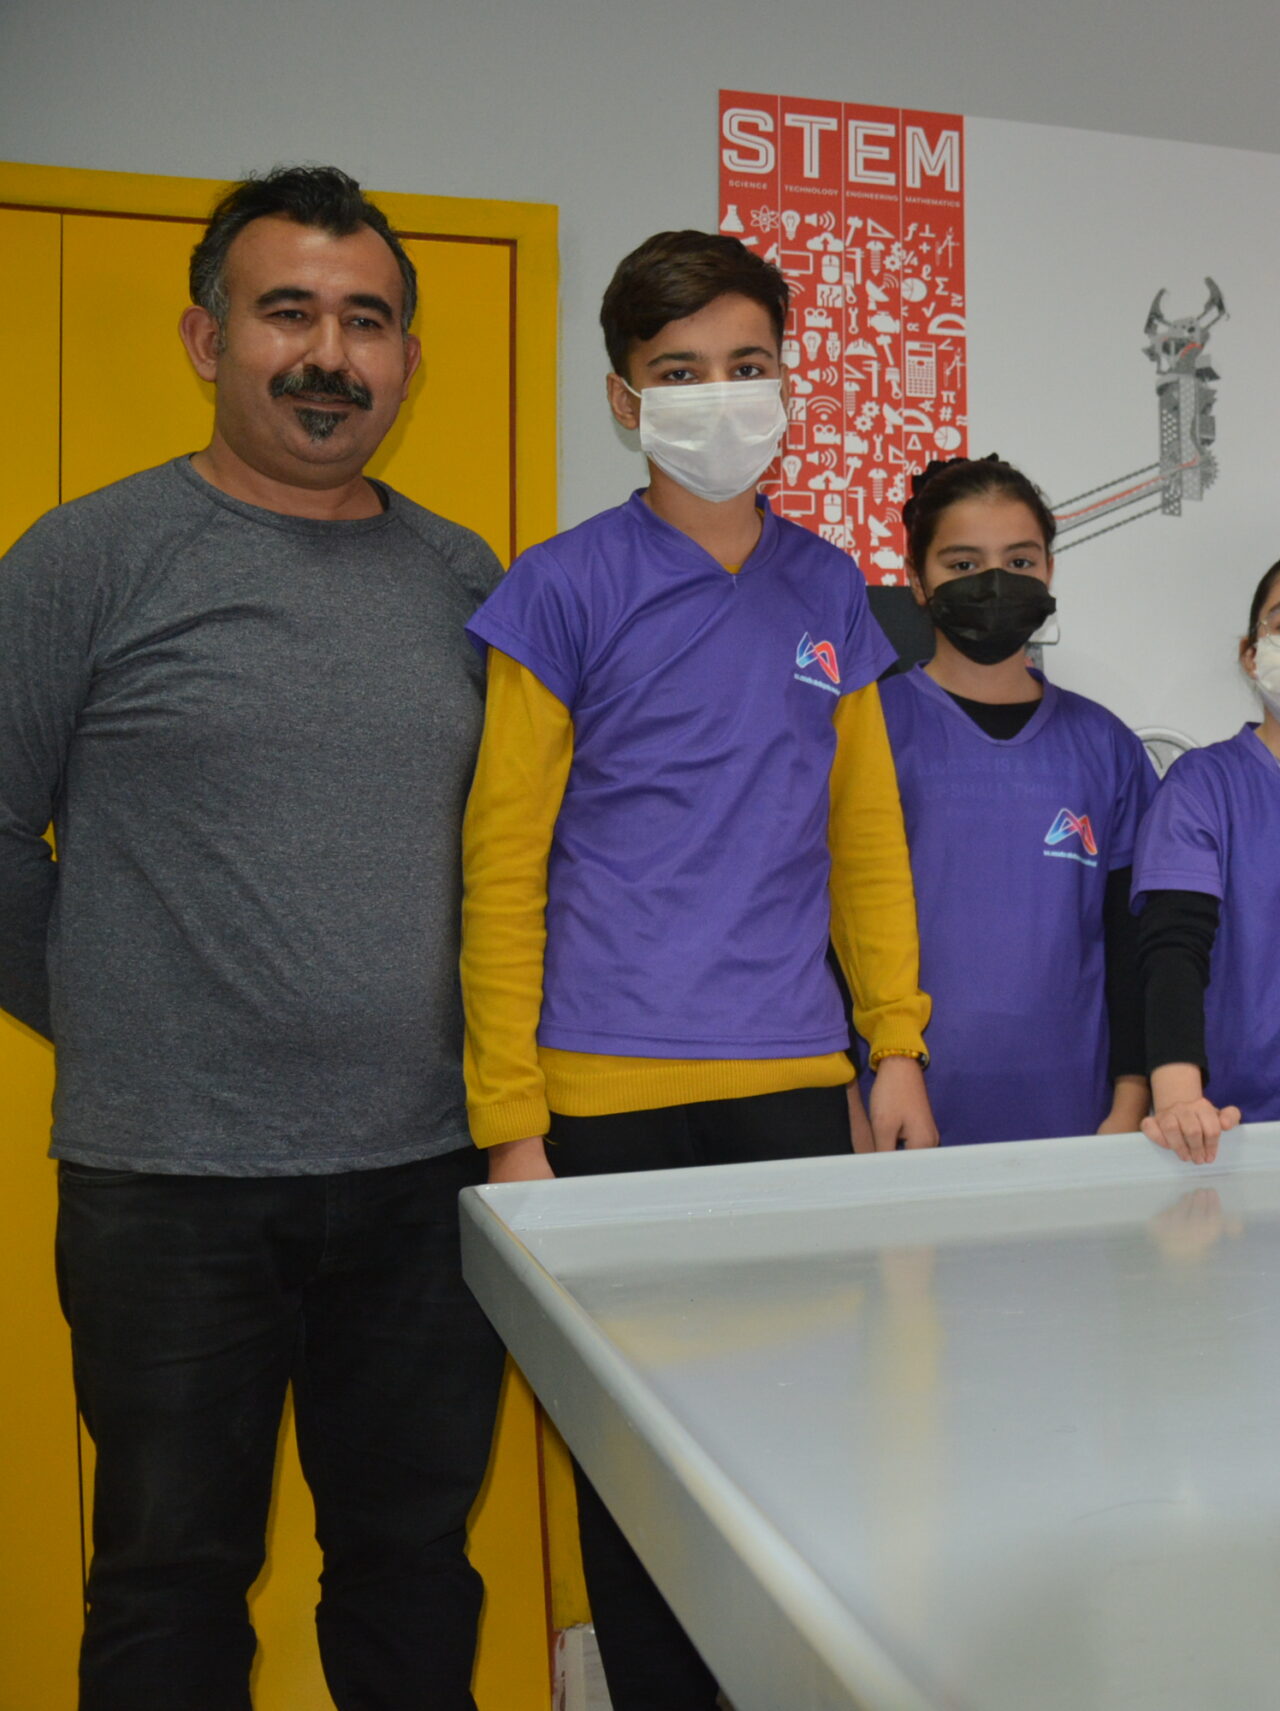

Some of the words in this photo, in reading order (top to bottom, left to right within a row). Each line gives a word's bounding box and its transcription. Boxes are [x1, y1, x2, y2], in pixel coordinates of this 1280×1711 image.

[722, 107, 961, 192] STEM
[728, 179, 768, 190] SCIENCE
[784, 184, 839, 196] TECHNOLOGY
[846, 190, 898, 202] ENGINEERING
[905, 196, 961, 208] MATHEMATICS
